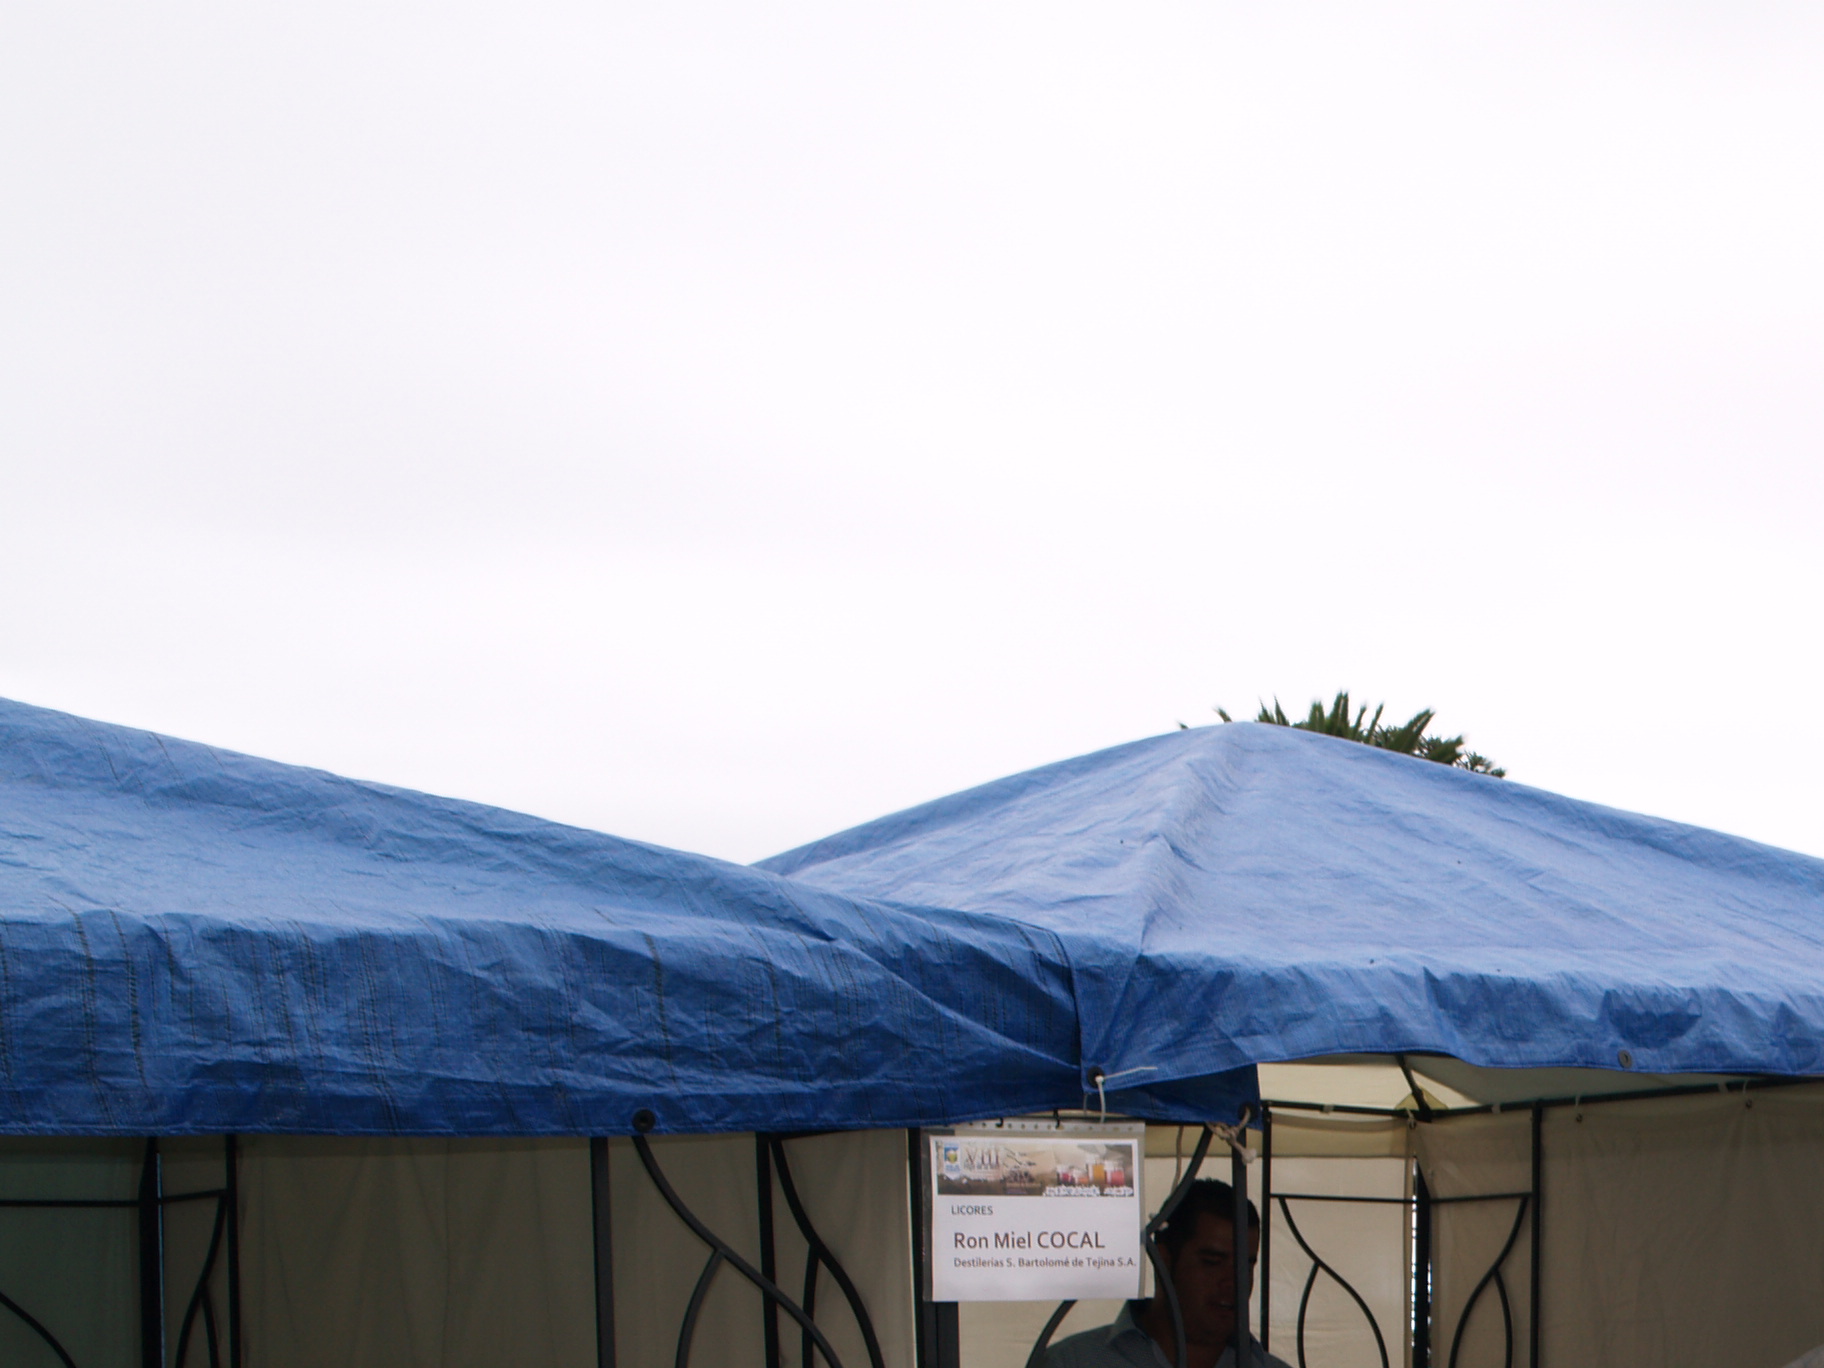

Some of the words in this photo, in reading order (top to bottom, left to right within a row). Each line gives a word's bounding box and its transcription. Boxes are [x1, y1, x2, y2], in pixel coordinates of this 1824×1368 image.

[951, 1205, 994, 1216] LICORES
[953, 1231, 989, 1250] Ron
[994, 1231, 1031, 1250] Miel
[1037, 1231, 1106, 1250] COCAL
[1018, 1256, 1070, 1268] Bartolomé
[1072, 1256, 1084, 1268] de
[1086, 1256, 1116, 1271] Tejina
[1117, 1257, 1138, 1268] S.A.
